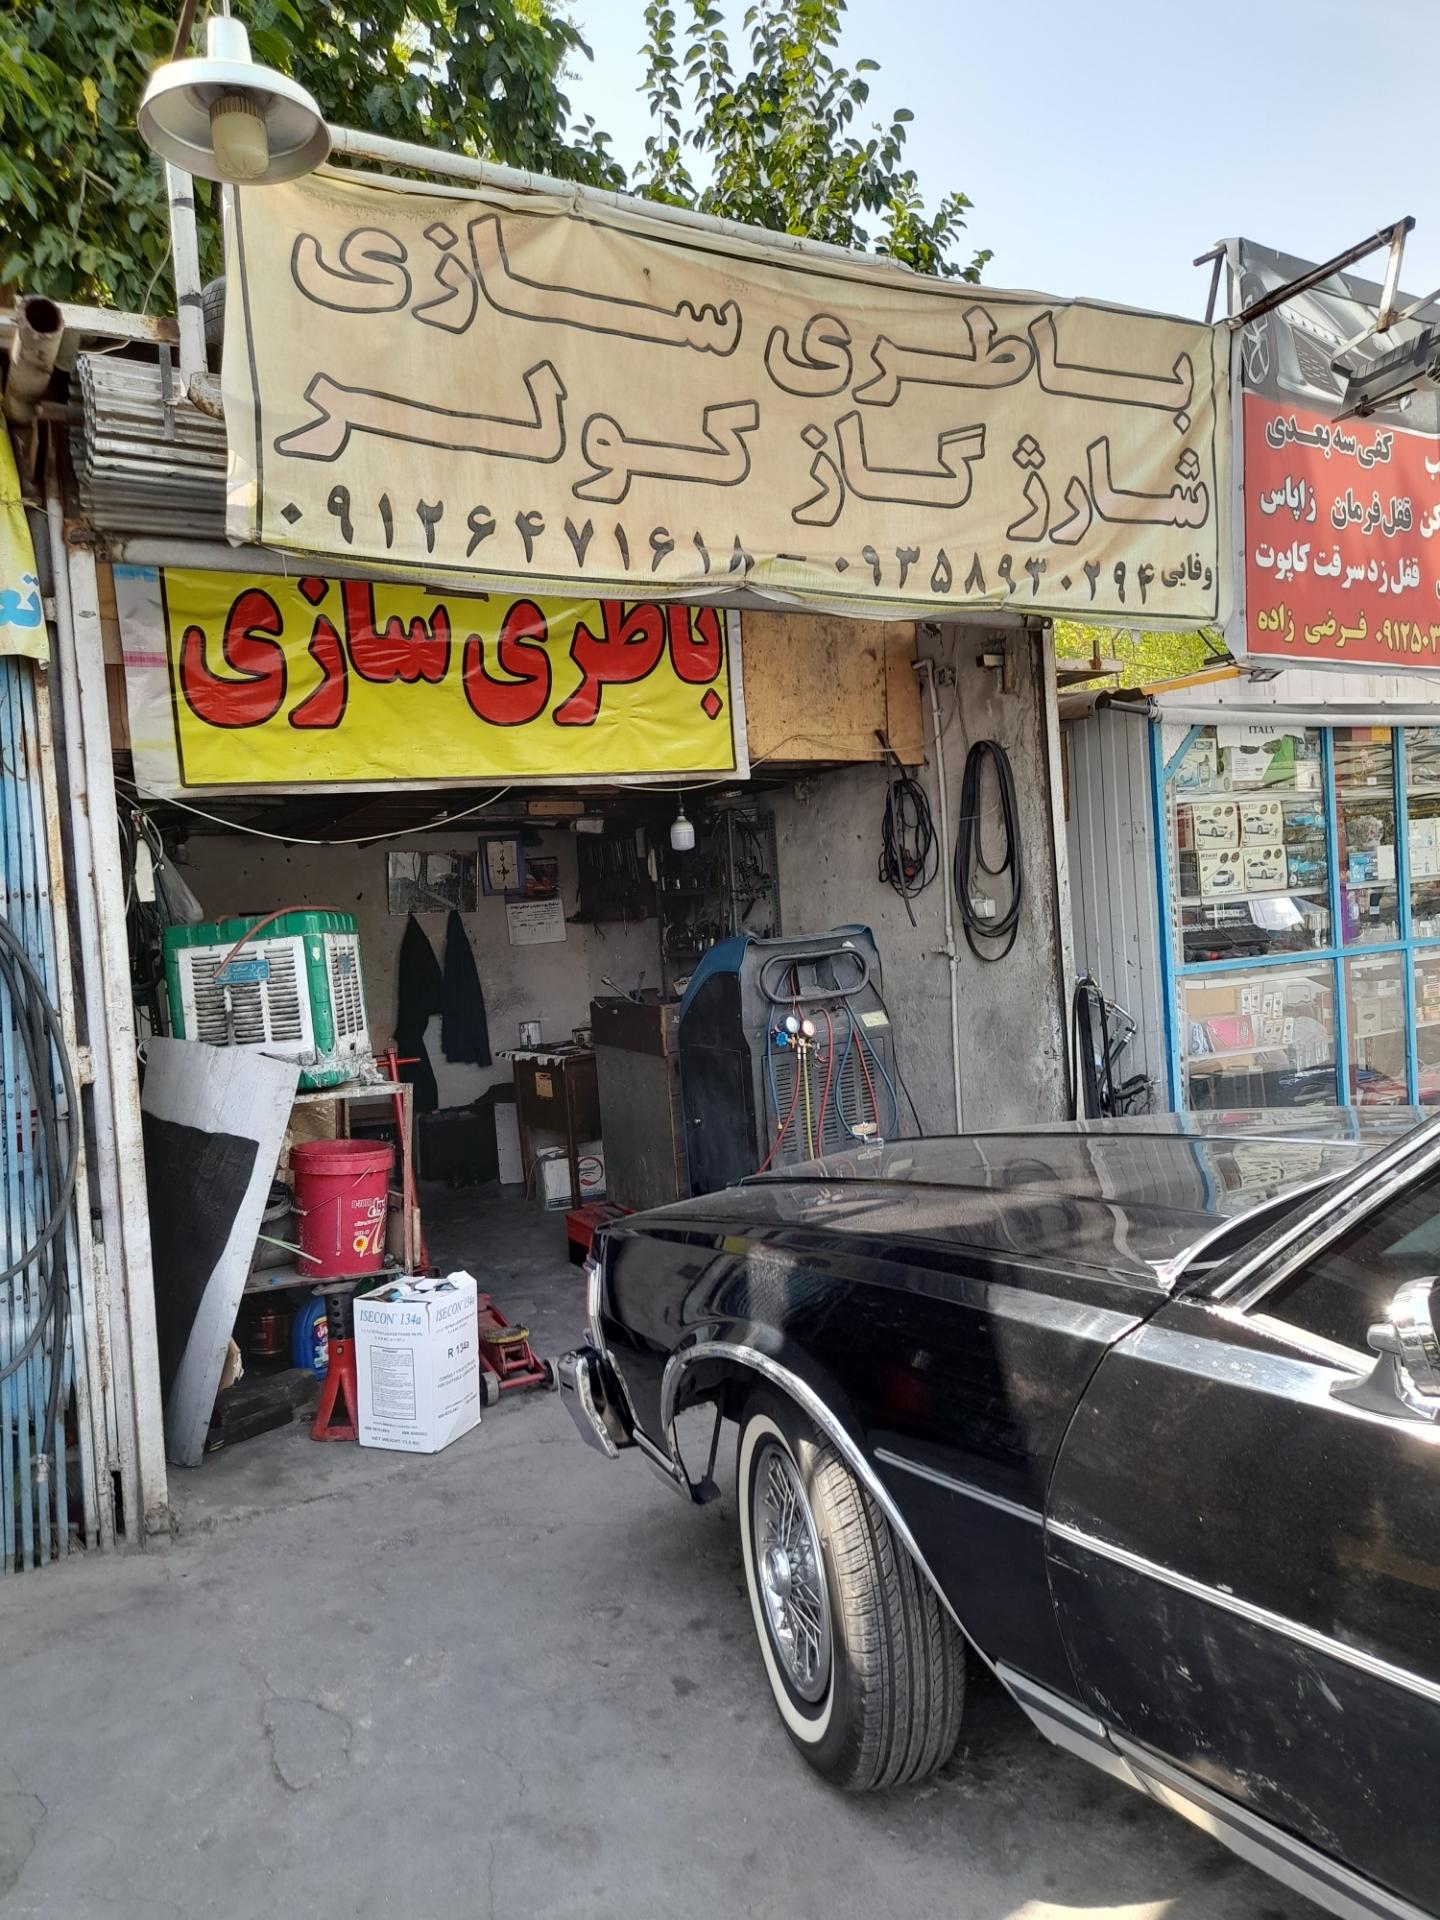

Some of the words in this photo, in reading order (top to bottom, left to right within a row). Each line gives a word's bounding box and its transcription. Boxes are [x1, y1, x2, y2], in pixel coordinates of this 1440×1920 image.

[291, 213, 743, 358] سازی
[764, 305, 1194, 434] باطری
[274, 360, 760, 505] کولر
[1266, 415, 1331, 458] بعدی
[1332, 424, 1356, 455] سه
[1357, 429, 1393, 469] کفی
[792, 409, 986, 527] گاز
[1006, 433, 1210, 545] شارژ
[1260, 476, 1317, 522] زاپاس
[1331, 488, 1382, 535] فرمان
[1382, 496, 1412, 537] قفل
[1161, 553, 1213, 590] وفایی
[1255, 540, 1310, 582] کاپوت
[1390, 557, 1420, 595] قفل
[1257, 603, 1296, 643] زاده
[1304, 611, 1368, 647] فرضی
[179, 577, 452, 729] سازی
[463, 598, 724, 727] باطری
[1248, 725, 1277, 735] ITALY
[400, 1313, 422, 1325] 134a
[435, 1300, 463, 1322] ISECON
[447, 1347, 454, 1359] R
